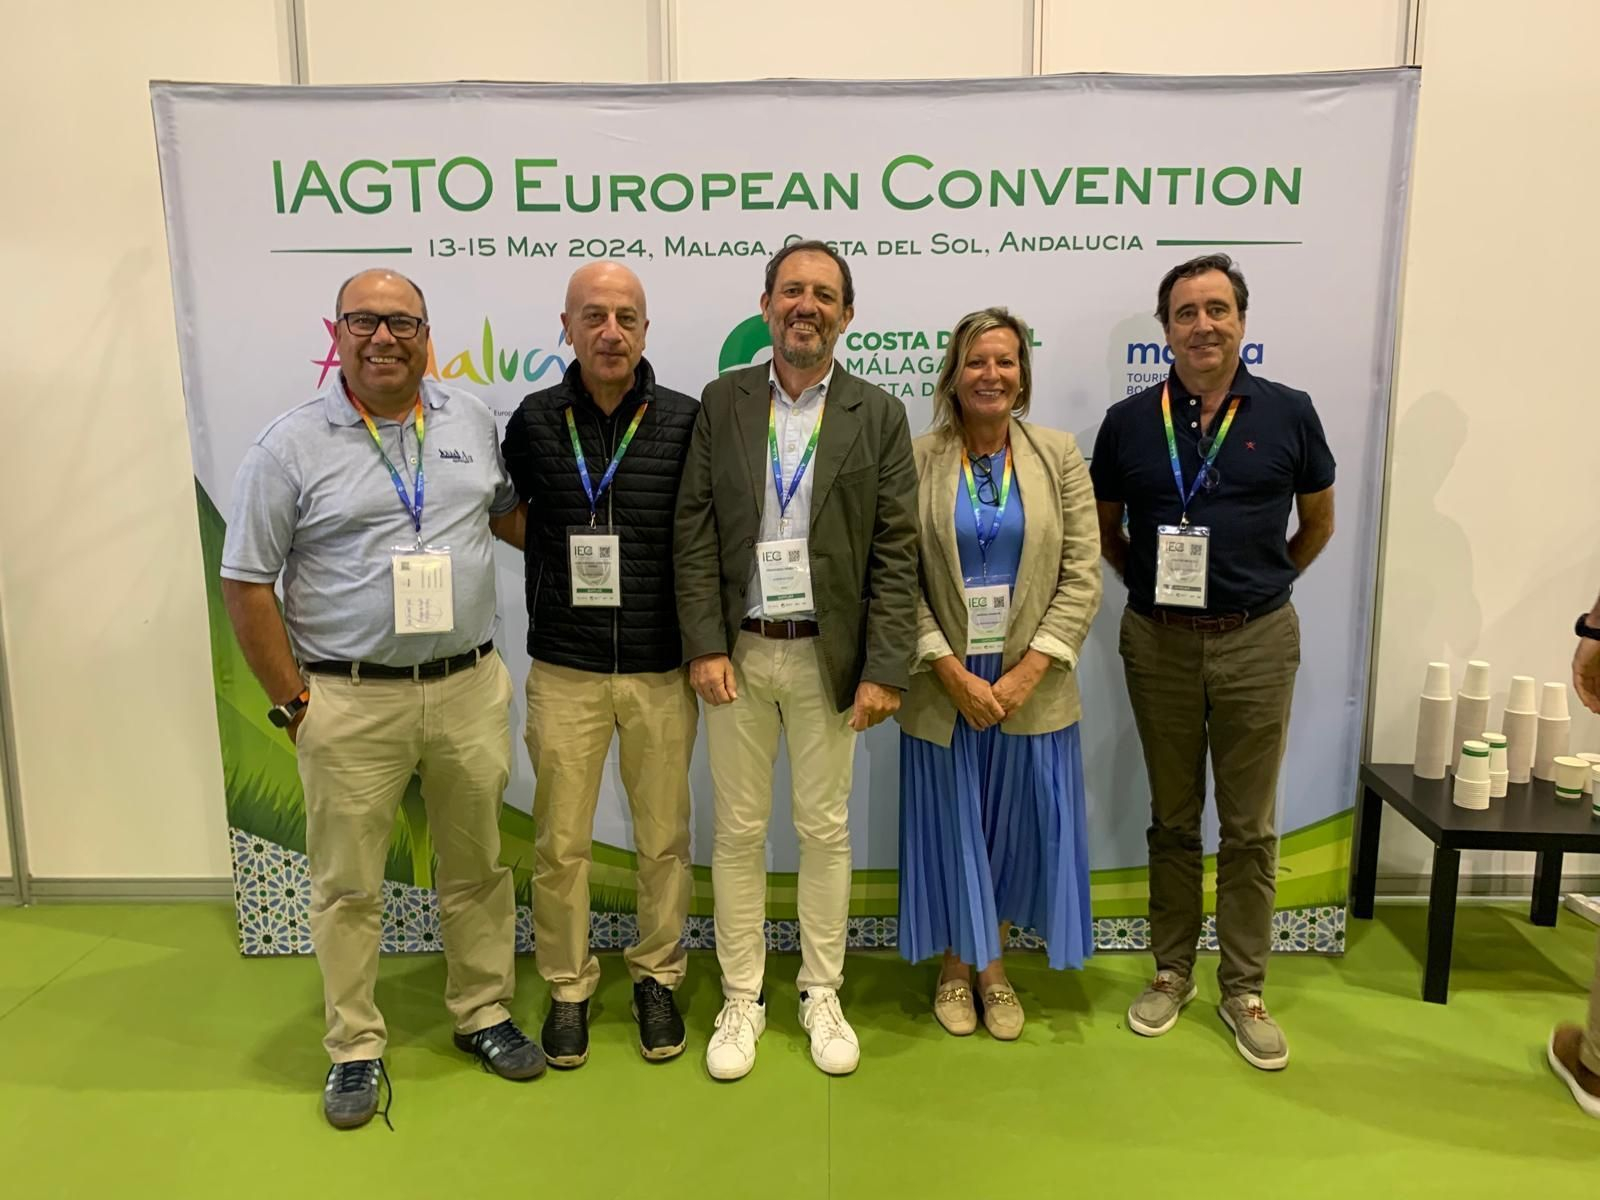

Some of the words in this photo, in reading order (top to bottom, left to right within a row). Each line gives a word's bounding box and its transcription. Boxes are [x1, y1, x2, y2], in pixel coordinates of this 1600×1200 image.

[272, 155, 494, 215] IAGTO
[514, 157, 859, 214] EUROPEAN
[881, 154, 1302, 212] CONVENTION
[429, 238, 496, 257] 13-15
[507, 236, 558, 257] MAY
[568, 238, 654, 261] 2024,
[877, 240, 922, 256] DEL
[998, 231, 1144, 253] ANDALUCIA
[846, 331, 930, 351] COSTA
